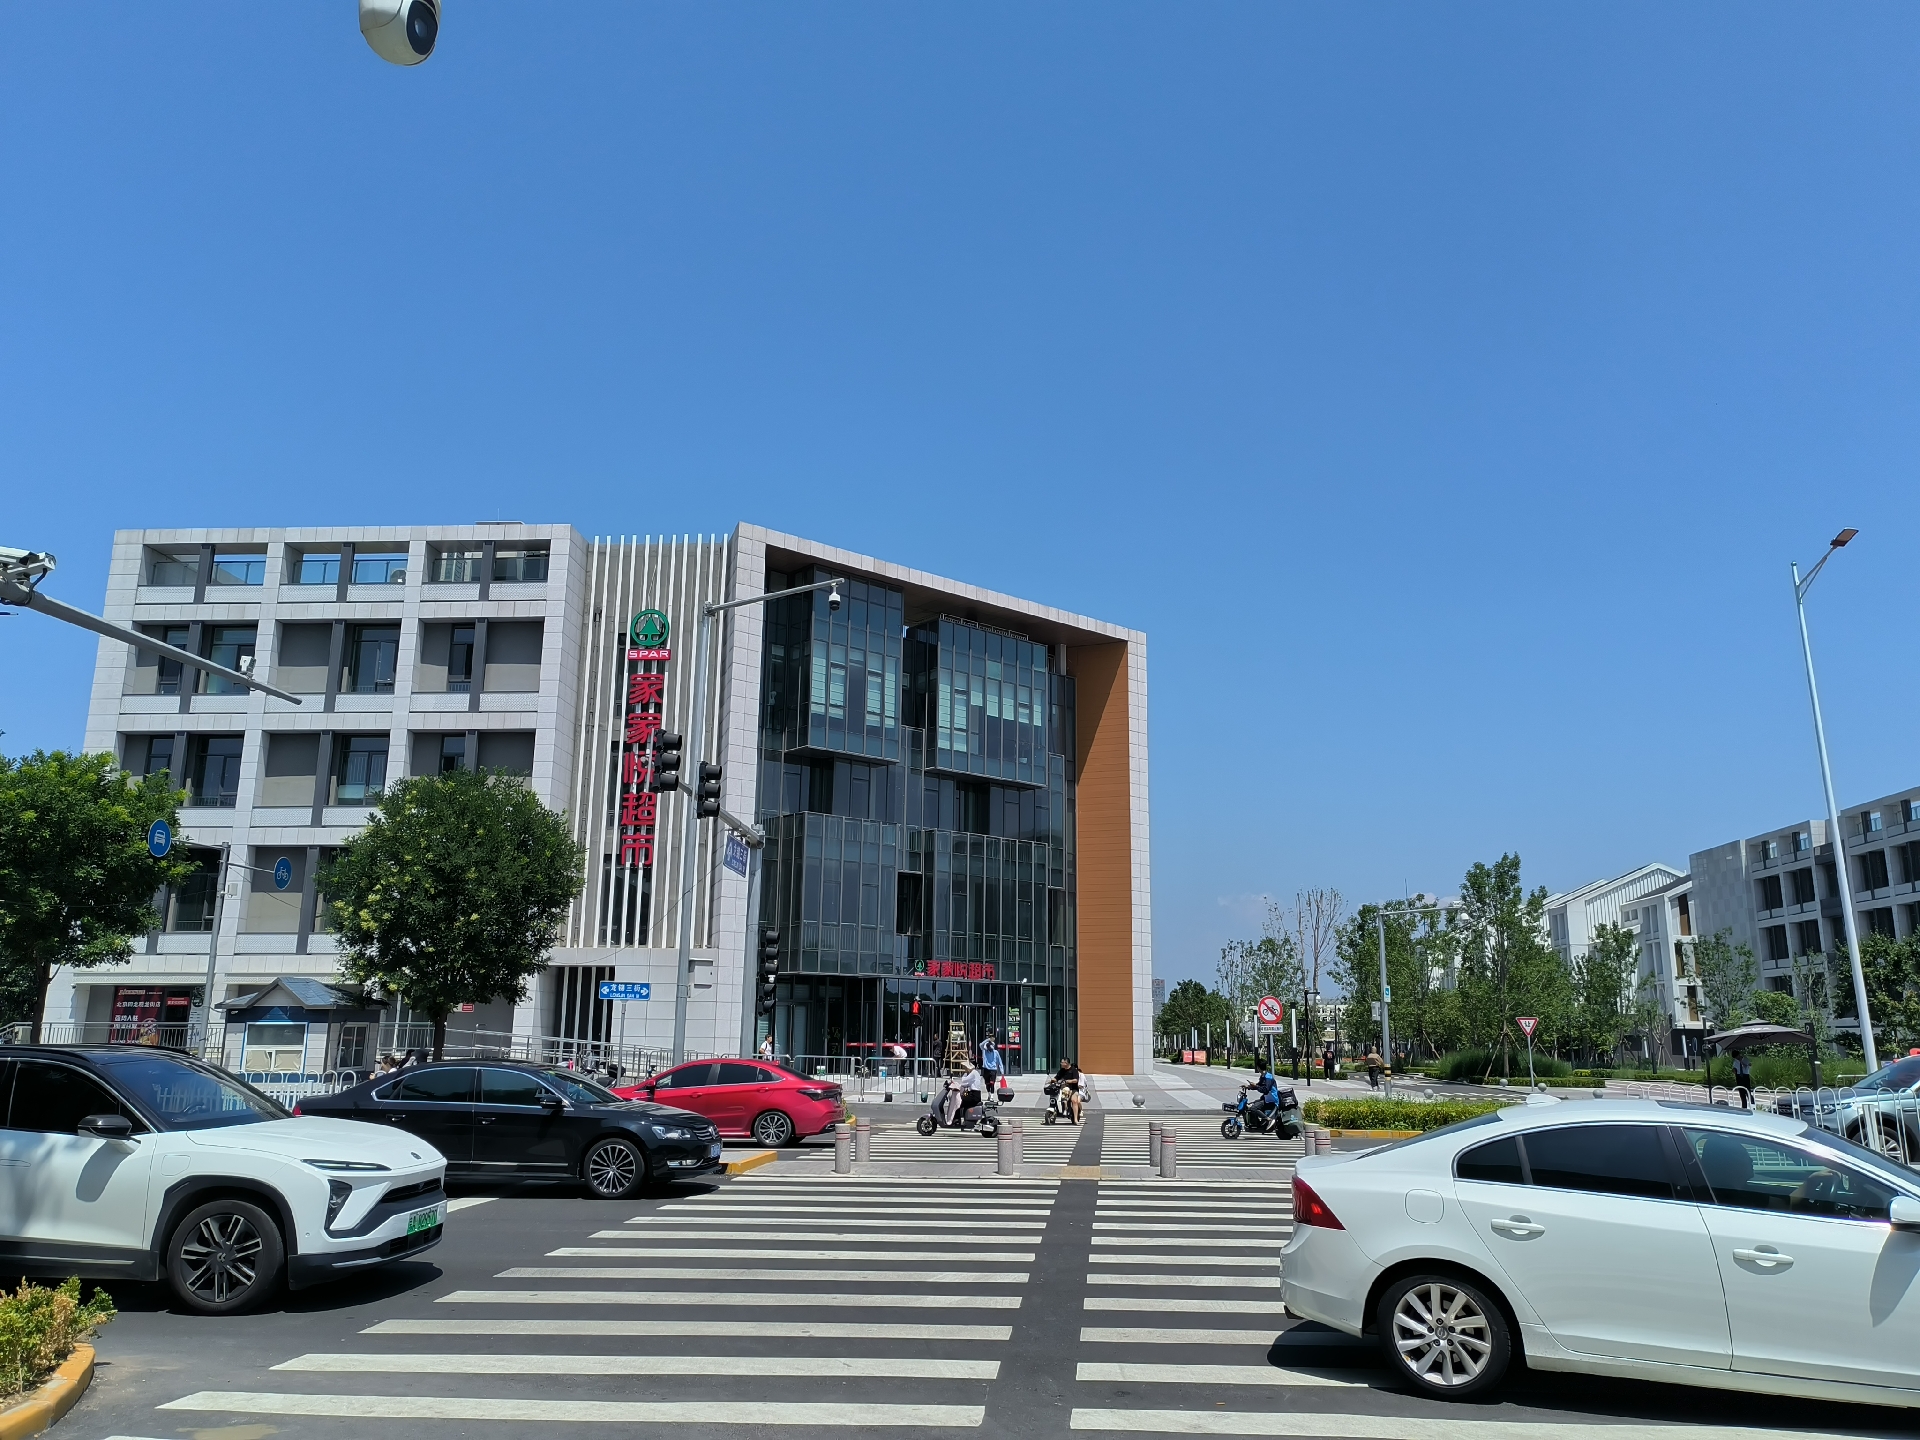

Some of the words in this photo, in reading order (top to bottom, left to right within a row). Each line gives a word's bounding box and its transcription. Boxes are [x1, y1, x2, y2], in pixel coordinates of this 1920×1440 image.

[629, 650, 669, 658] SPAR
[926, 960, 995, 980] 家家悦超市
